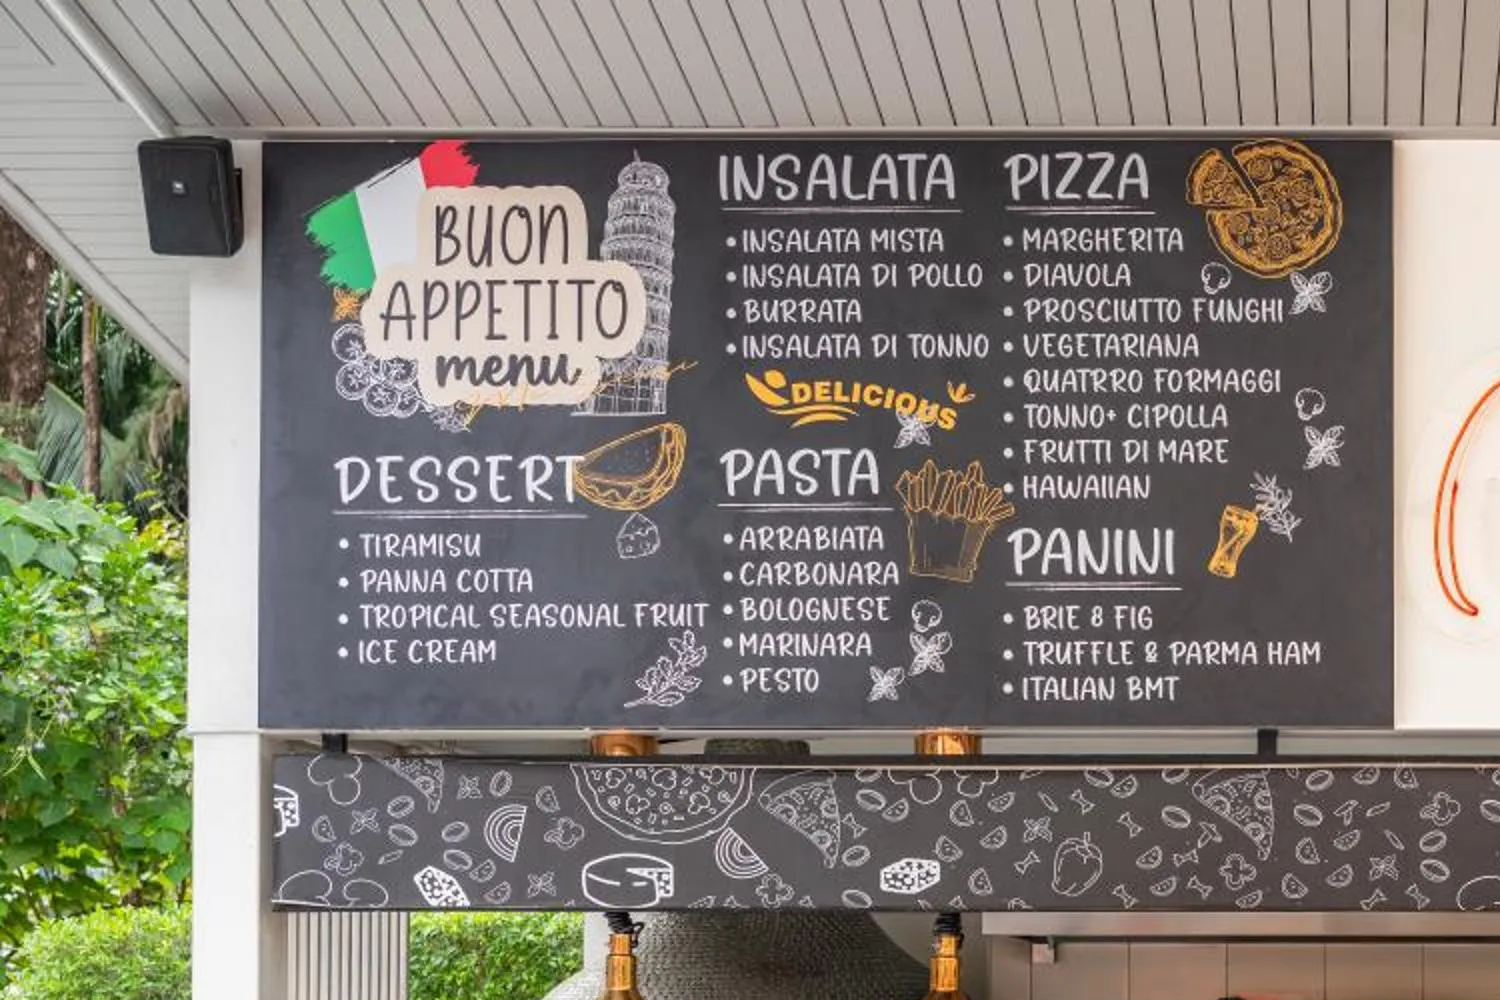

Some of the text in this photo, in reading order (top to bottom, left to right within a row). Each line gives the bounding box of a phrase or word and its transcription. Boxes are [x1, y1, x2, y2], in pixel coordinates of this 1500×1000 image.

[718, 153, 956, 201] INSALATA
[1003, 152, 1150, 201] PIZZA
[434, 204, 570, 268] BUON
[743, 228, 944, 253] INSALATA MISTA
[1023, 227, 1185, 253] MARGHERITA
[743, 263, 983, 289] INSALATA DI POLLO
[1023, 263, 1132, 288] DIAVOLA
[380, 279, 629, 342] APPETITO
[743, 299, 863, 324] BURRATA
[1023, 297, 1283, 323] PROSCIUTTO FUNGHI
[743, 334, 990, 359] INSALATA DI TONNO
[1023, 333, 1200, 359] VEGETARIANA
[436, 353, 582, 388] menu
[1154, 368, 1281, 394] FORMAGGI
[791, 381, 957, 430] DELICIOUS
[1127, 403, 1229, 429] CIPOLLA
[1023, 438, 1229, 464] FRUTTI DI MARE
[333, 455, 586, 505] DESSERT
[719, 448, 879, 497] PASTA
[1023, 475, 1151, 500] HAWAIIAN
[359, 533, 481, 558] TIRAMISU
[739, 526, 885, 551] ARRABIATA
[1007, 527, 1175, 577] PANINI
[360, 567, 534, 594] PANNA COTTA
[739, 561, 899, 586] CARBONARA
[360, 602, 710, 630] TROPICAL SEASONAL FRUIT
[740, 597, 892, 622] BOLOGNESE
[1023, 605, 1081, 631] BRIE
[1114, 605, 1153, 631] FIG
[358, 639, 497, 664] ICE CREAM
[739, 632, 872, 657] MARINARA
[1023, 640, 1322, 666] TRUFFLE & PARMA HAM
[740, 667, 819, 693] PESTO
[1022, 676, 1180, 702] ITALIAN BMT
